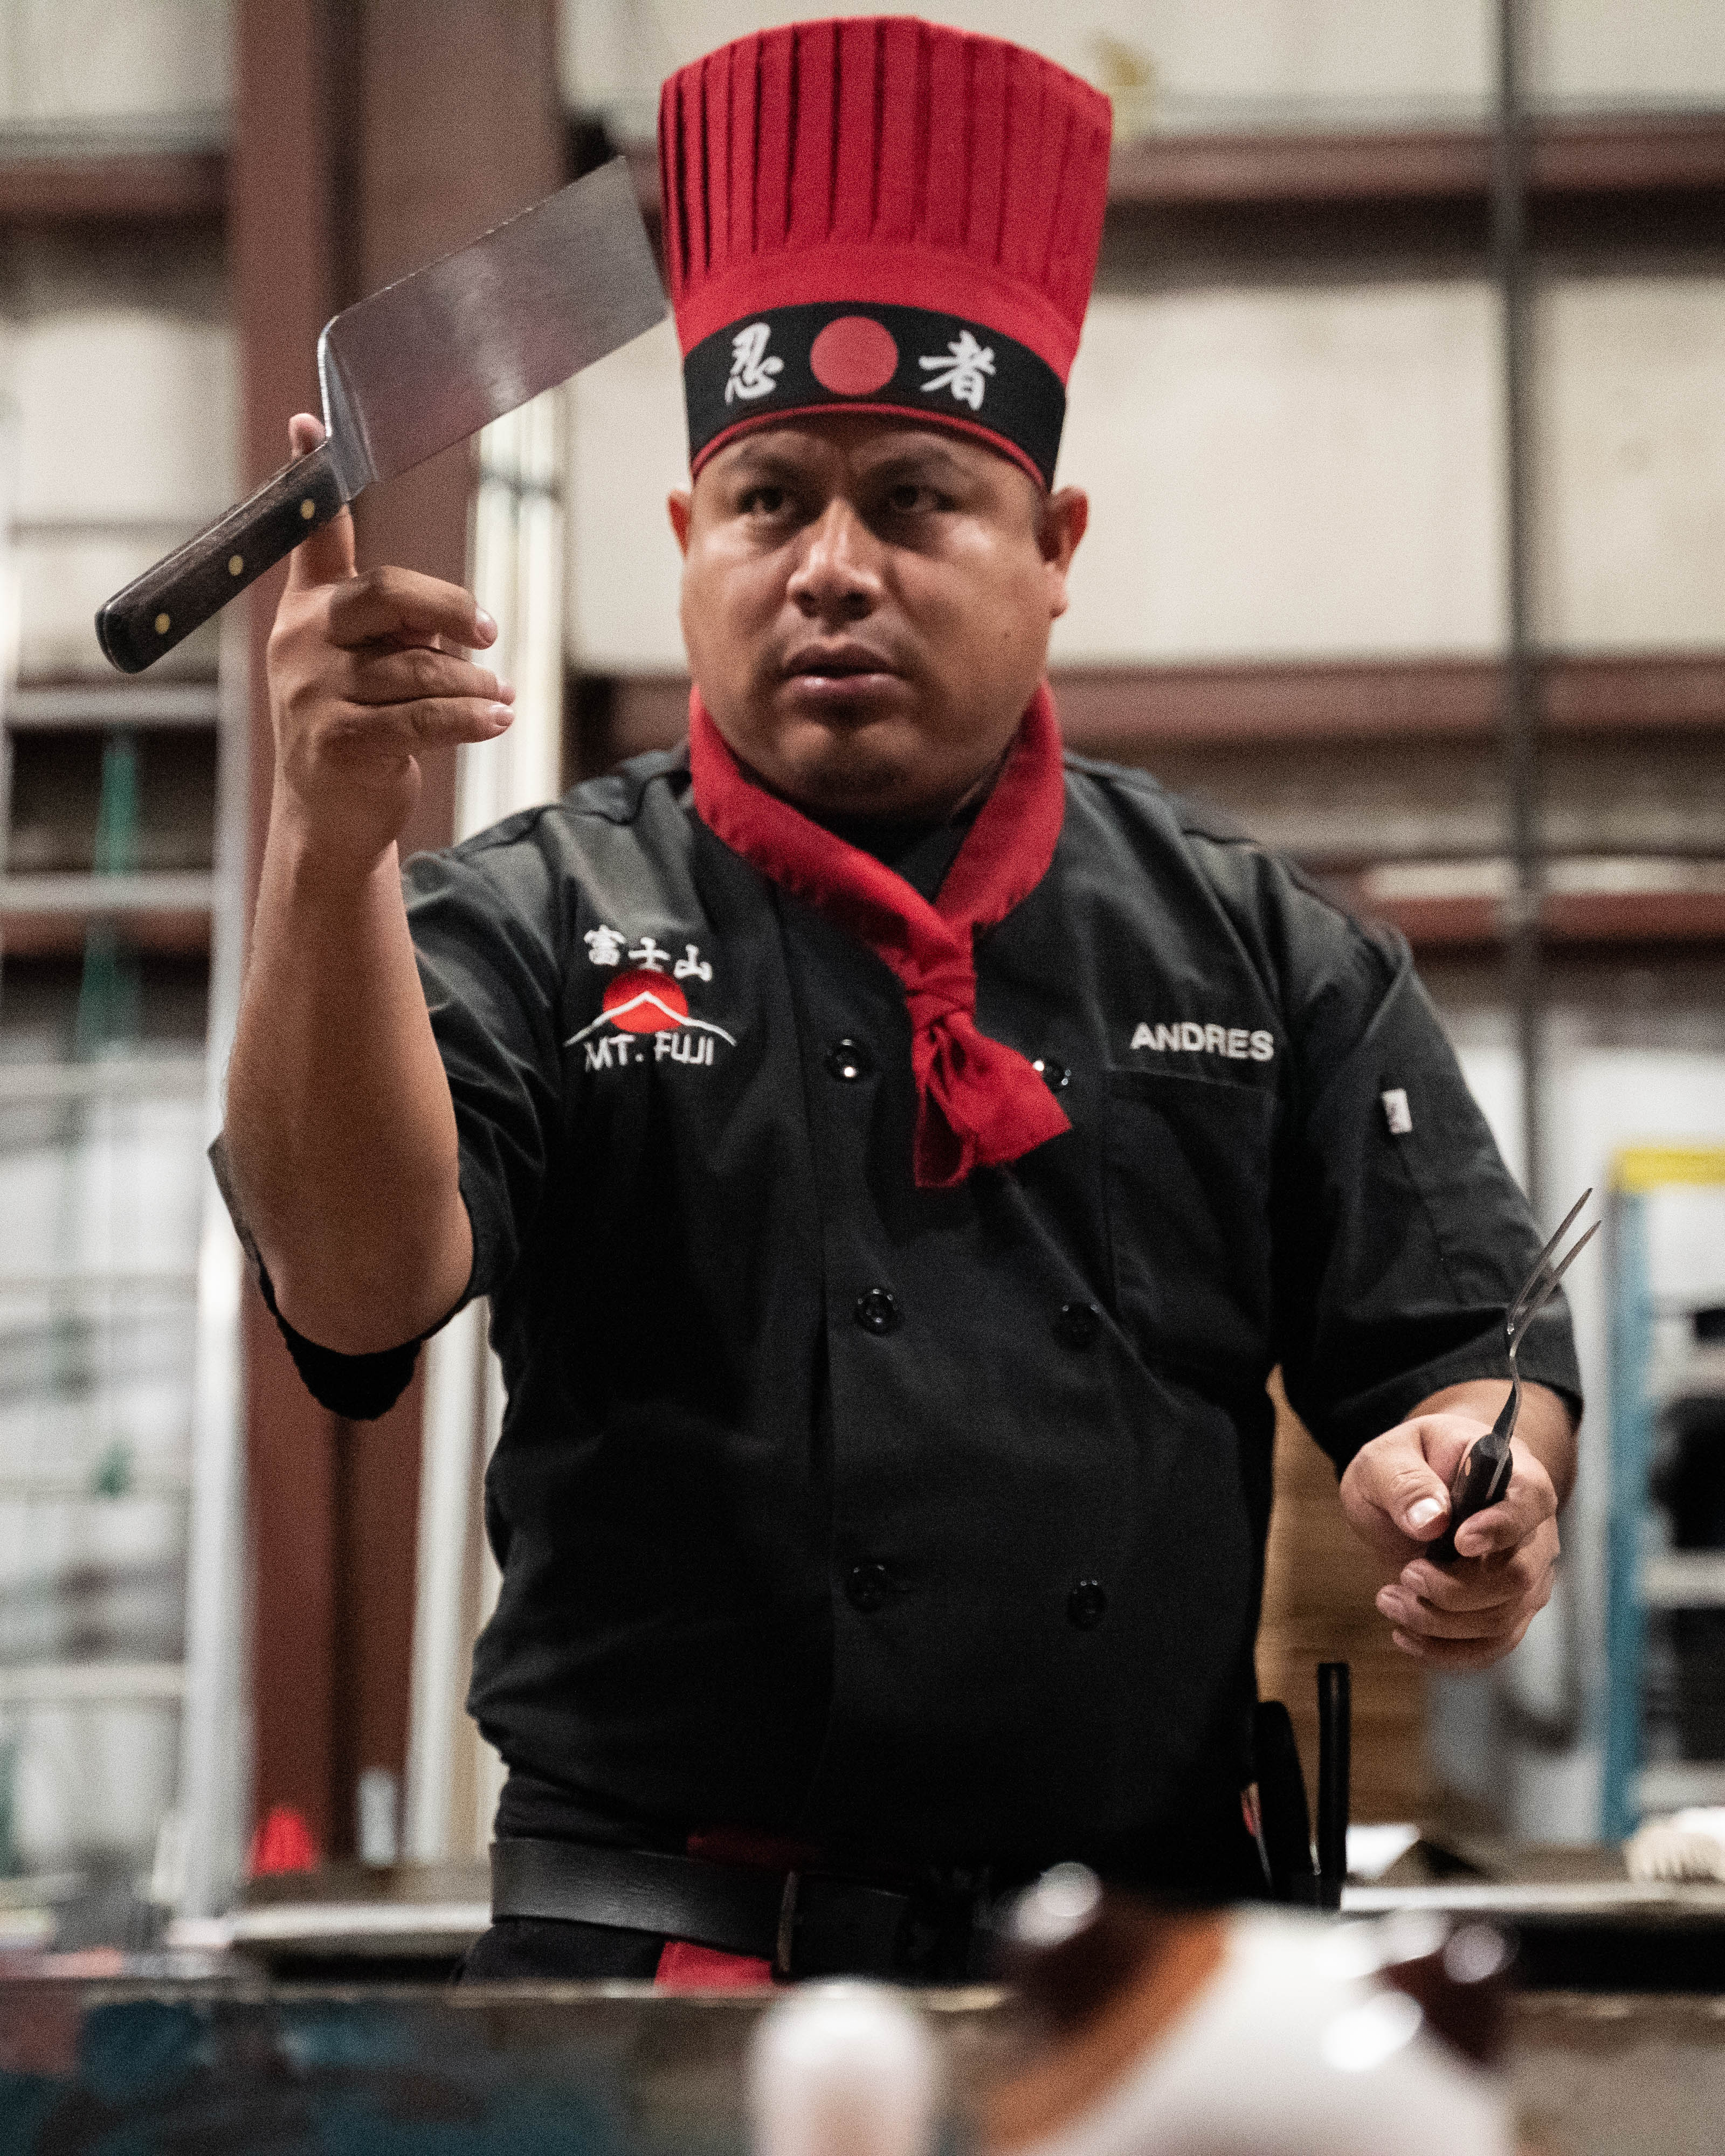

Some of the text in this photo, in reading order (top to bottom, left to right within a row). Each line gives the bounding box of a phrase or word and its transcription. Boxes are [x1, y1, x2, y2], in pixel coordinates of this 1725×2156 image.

[724, 322, 996, 410] 忍 者
[583, 924, 713, 982] 富士山
[584, 1031, 714, 1072] MT. FUJI
[1130, 1022, 1274, 1061] ANDRES
